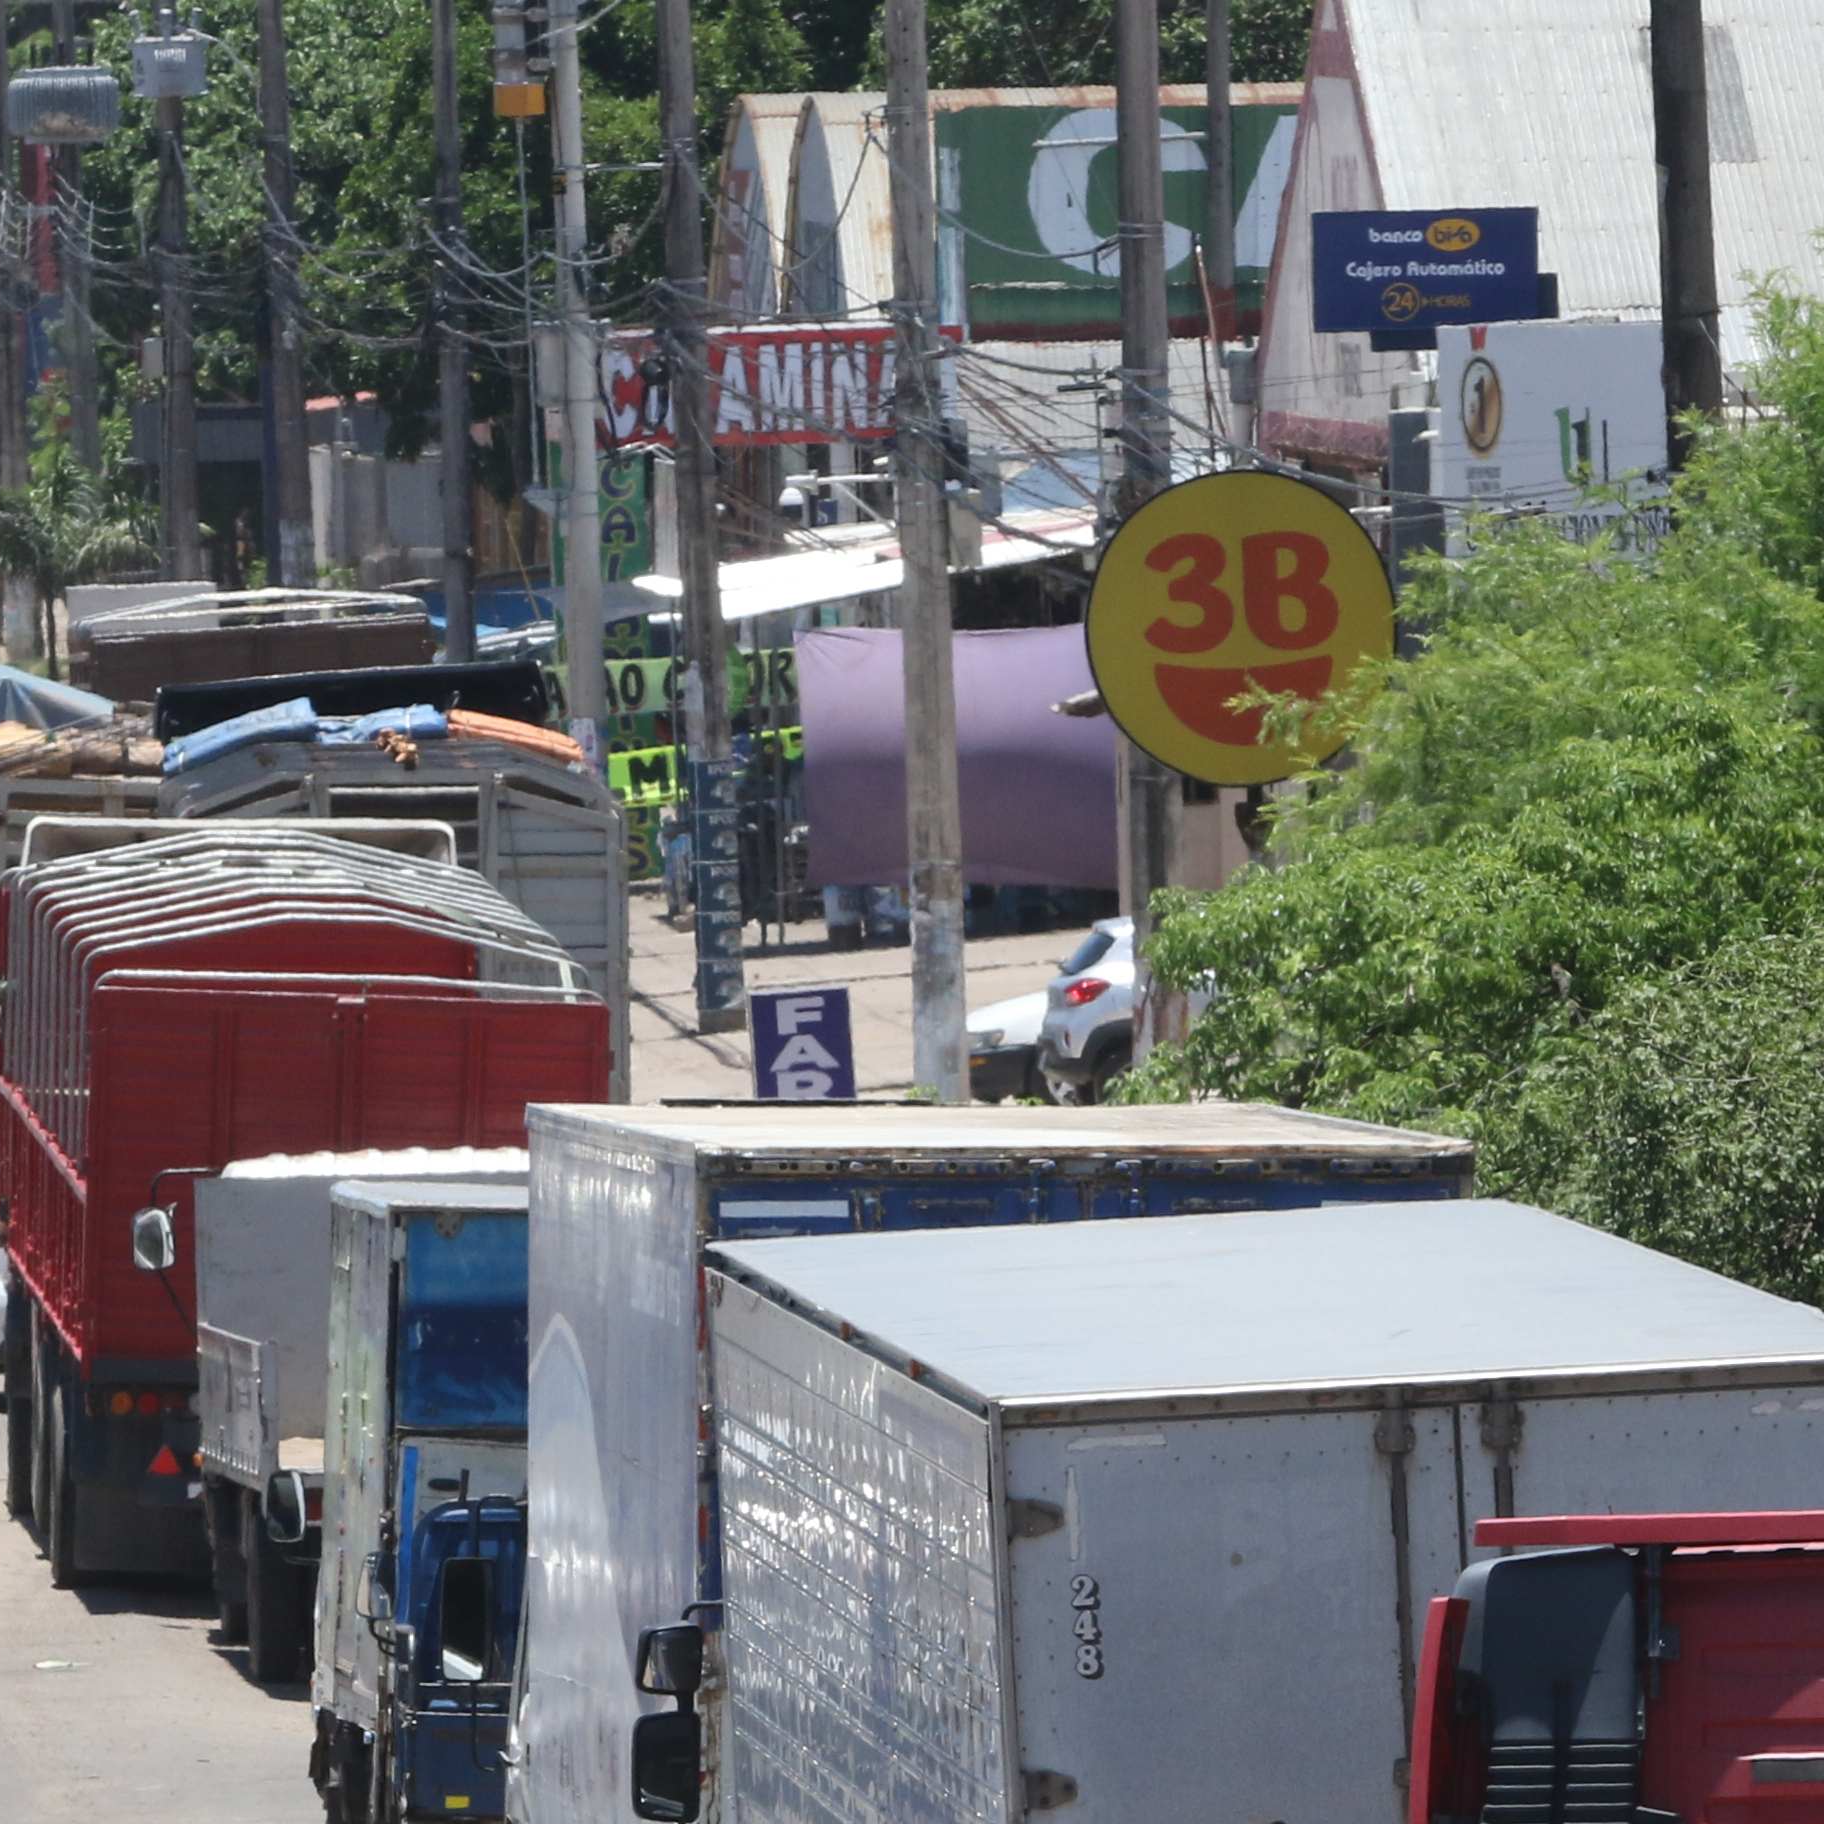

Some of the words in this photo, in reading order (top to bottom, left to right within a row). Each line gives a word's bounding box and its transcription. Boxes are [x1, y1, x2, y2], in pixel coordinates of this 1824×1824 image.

[1369, 227, 1423, 243] banco
[1346, 261, 1402, 281] Cajero
[1407, 259, 1505, 276] Automático
[1388, 289, 1414, 312] 24
[1144, 531, 1339, 653] 3B
[1071, 1574, 1104, 1679] 248
